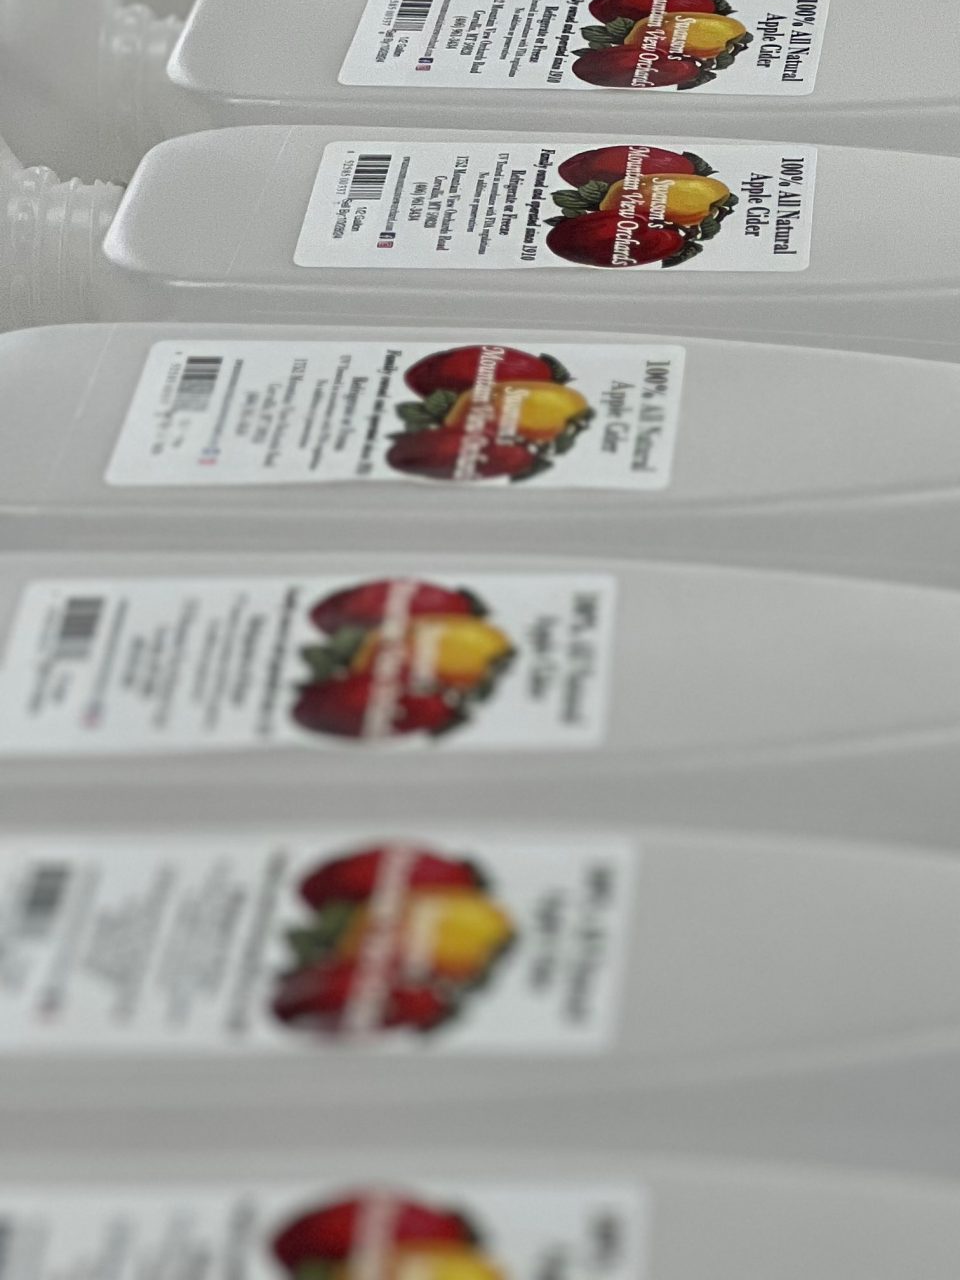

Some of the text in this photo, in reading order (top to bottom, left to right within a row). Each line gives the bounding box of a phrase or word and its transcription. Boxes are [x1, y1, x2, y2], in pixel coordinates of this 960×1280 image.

[486, 4, 504, 27] Mountain
[536, 6, 559, 37] Refrigerate
[562, 24, 576, 34] and
[465, 33, 478, 41] MT
[482, 29, 497, 39] View
[640, 29, 666, 51] View
[667, 16, 697, 60] Swanson's
[756, 13, 787, 68] Apple Cider
[790, 30, 812, 44] All
[630, 53, 660, 87] Orchards
[781, 47, 810, 82] Natural
[502, 170, 526, 203] Refrigerate
[408, 197, 424, 221] 961-3434
[428, 201, 441, 211] MT
[436, 156, 469, 251] 1752 Mountain View Orchards Road
[520, 149, 555, 260] Family owned and operated since 1910
[611, 146, 651, 266] Mountain View Orchards
[647, 178, 675, 229] Swanson's
[741, 172, 773, 237] Apple Cider
[773, 158, 805, 255] 100% All Natural
[352, 216, 366, 231] Gallon
[499, 214, 517, 235] Freeze
[474, 346, 505, 401] Mountain
[642, 360, 670, 399] 100%
[601, 381, 636, 418] Apple
[641, 404, 664, 421] All
